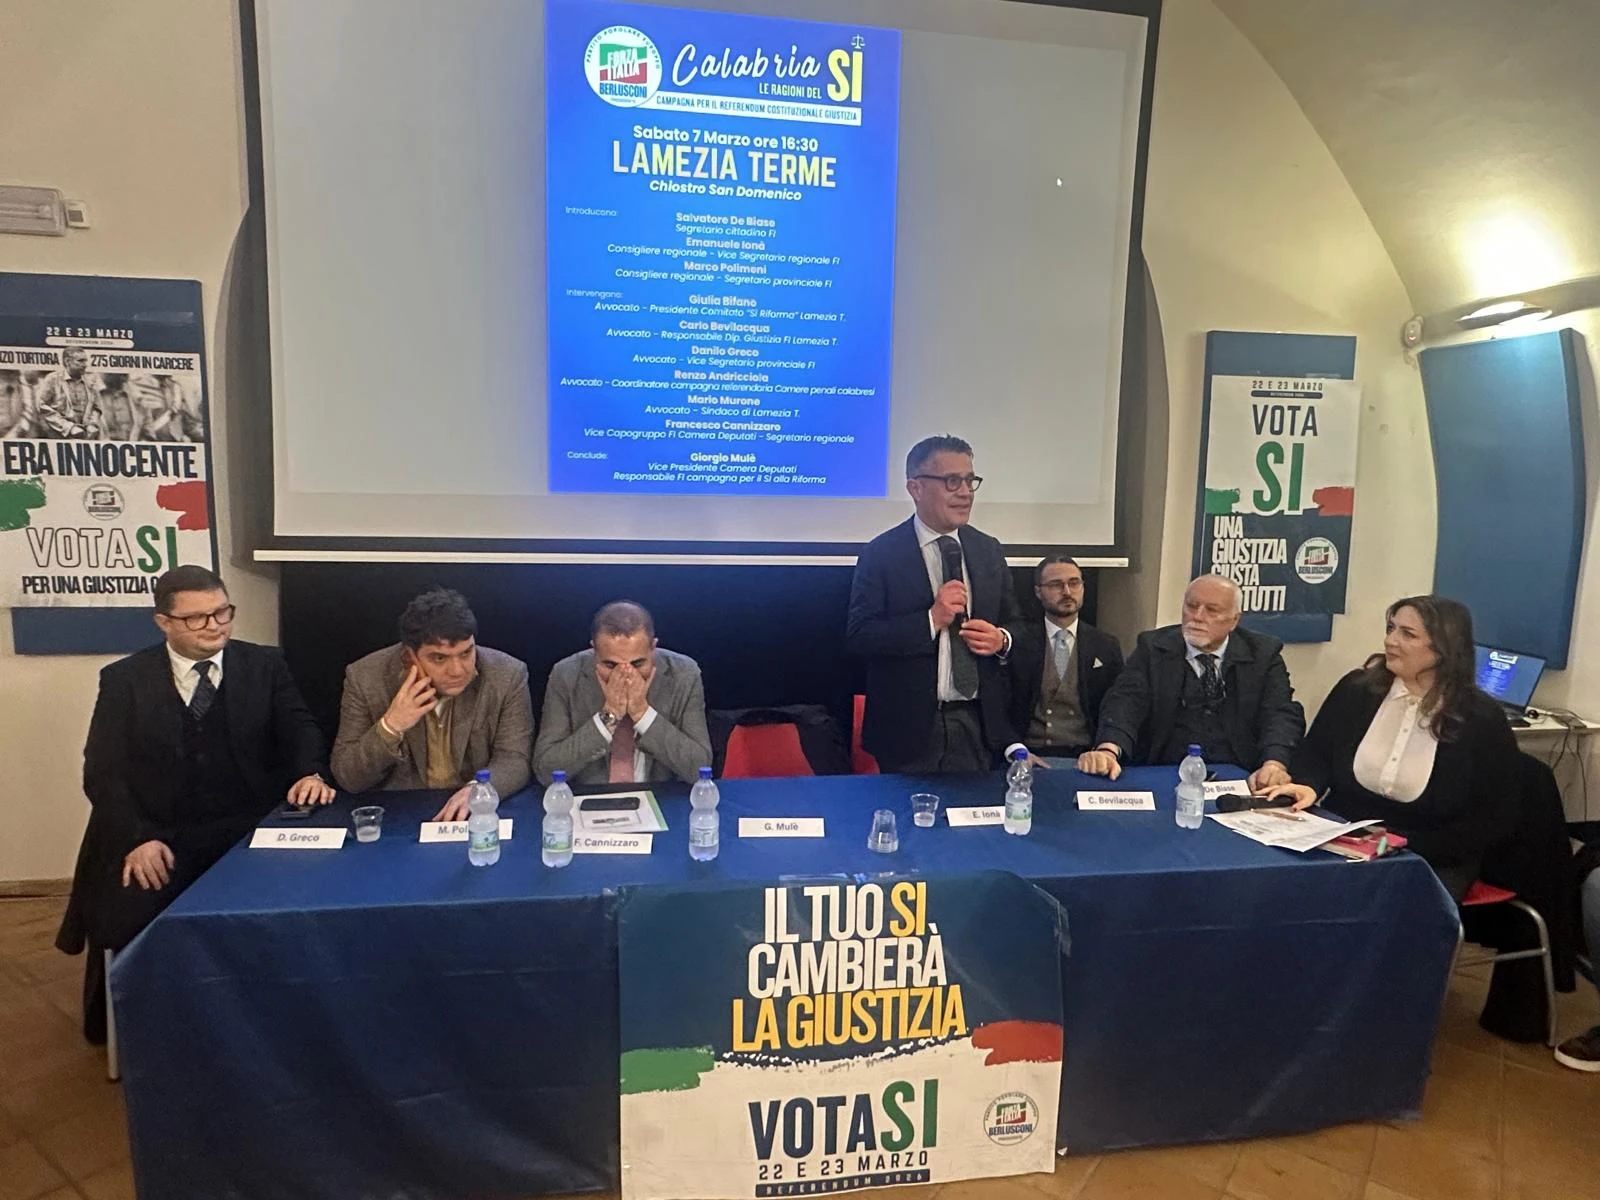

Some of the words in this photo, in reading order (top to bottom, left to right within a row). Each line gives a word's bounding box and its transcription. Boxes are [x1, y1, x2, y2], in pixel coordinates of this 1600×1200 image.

[607, 62, 640, 80] ITALIA
[672, 43, 821, 87] Calabria
[599, 82, 648, 98] BERLUSCONI
[759, 82, 769, 95] LE
[771, 84, 805, 98] RAGIONI
[807, 87, 822, 99] DEL
[656, 95, 695, 108] CAMPAGNA
[696, 99, 710, 108] PER
[719, 101, 765, 113] REFERENDUM
[767, 106, 823, 118] COSTITUZIONALE
[824, 110, 857, 121] GIUSTIZIA
[633, 125, 689, 141] Sabato
[692, 130, 701, 142] 7
[703, 131, 751, 146] Marzo
[753, 137, 778, 149] ore
[781, 136, 819, 152] 16:30
[612, 140, 738, 181] LAMEZIA
[748, 151, 837, 188] TERME
[649, 180, 706, 194] Chiostro
[708, 183, 735, 197] San
[736, 186, 802, 201] Domenico
[675, 212, 728, 224] Salvatore
[730, 215, 745, 225] De
[746, 217, 775, 227] Biase
[675, 224, 723, 236] Segretario
[725, 227, 766, 237] cittadino
[686, 237, 740, 248] Emanuele
[607, 243, 660, 256] Consigliere
[662, 247, 707, 258] regionale
[717, 250, 737, 259] Vice
[739, 251, 786, 262] Segretario
[787, 255, 830, 265] regionale
[683, 261, 719, 272] Marco
[720, 263, 767, 274] Polimeni
[615, 268, 668, 280] Consigliere
[670, 272, 714, 283] regionale
[724, 274, 771, 285] Segretario
[772, 278, 823, 288] provinciale
[688, 295, 720, 305] Giulia
[722, 296, 757, 307] Bifano
[594, 302, 640, 312] Avvocato
[649, 304, 699, 315] Presidente
[700, 306, 744, 317] Comitato
[800, 312, 837, 321] Lamezia
[46, 326, 60, 336] 22
[65, 327, 72, 336] E
[77, 327, 91, 337] 23
[96, 328, 134, 339] MARZO
[679, 320, 709, 330] Carlo
[710, 321, 770, 334] Bevilacqua
[606, 328, 652, 338] Avvocato
[661, 330, 723, 341] Responsabile
[744, 334, 781, 344] Giustizia
[792, 336, 830, 346] Lamezia
[15, 351, 60, 365] TORTORA
[691, 345, 726, 356] Danilo
[727, 347, 759, 357] Greco
[90, 354, 108, 367] 275
[109, 355, 141, 369] GIORNI
[142, 356, 151, 369] IN
[152, 356, 194, 370] CARCERE
[632, 354, 677, 364] Avvocato
[687, 356, 706, 365] Vice
[708, 357, 755, 368] Segretario
[756, 359, 806, 369] provinciale
[674, 369, 706, 380] Renzo
[560, 377, 603, 387] Avvocato
[611, 379, 669, 389] Coordinatore
[670, 382, 720, 393] campagna
[721, 383, 773, 393] referendaria
[774, 384, 809, 394] Camere
[809, 386, 837, 396] penali
[837, 386, 876, 396] calabresi
[1252, 380, 1263, 389] 22
[1268, 380, 1273, 389] E
[1277, 381, 1288, 390] 23
[1293, 381, 1323, 391] MARZO
[687, 395, 719, 404] Mario
[720, 396, 761, 406] Murone
[645, 405, 691, 414] Avvocato
[701, 406, 740, 416] Sindaco
[741, 407, 751, 417] di
[752, 408, 792, 417] Lamezia
[665, 419, 721, 430] Francesco
[722, 421, 781, 431] Cannizzaro
[1252, 404, 1318, 436] VOTA
[583, 428, 604, 437] Vice
[606, 428, 666, 440] Capogruppo
[678, 430, 716, 439] Camera
[717, 431, 757, 442] Deputati
[765, 432, 812, 443] Segretario
[813, 435, 855, 445] regionale
[3, 441, 55, 475] ERA
[56, 442, 198, 479] INNOCENTE
[690, 452, 729, 464] Giorgio
[730, 452, 756, 463] Mulè
[648, 462, 668, 471] Vice
[669, 463, 718, 472] Presidente
[719, 464, 757, 473] Camera
[758, 464, 797, 475] Deputati
[1252, 440, 1305, 512] SI
[613, 471, 675, 482] Responsabile
[686, 474, 737, 484] campagna
[738, 475, 754, 484] per
[773, 475, 791, 483] alla
[791, 475, 826, 484] Riforma
[1213, 515, 1244, 539] UNA
[1211, 538, 1288, 564] GIUSTIZIA
[21, 575, 49, 594] PER
[52, 576, 81, 594] UNA
[82, 576, 149, 594] GIUSTIZIA
[1242, 585, 1287, 612] TUTTI
[1098, 796, 1144, 806] Bevilacqua
[438, 825, 449, 834] M.
[764, 822, 774, 831] G.
[776, 822, 799, 831] Mulè
[277, 833, 287, 841] D.
[290, 833, 320, 842] Greco
[584, 838, 639, 847] Cannizzaro
[765, 887, 800, 943] IL
[804, 883, 884, 941] TUO
[889, 881, 927, 937] SI
[748, 922, 947, 999] CAMBIERÀ
[732, 998, 782, 1052] LA
[786, 984, 967, 1049] GIUSTIZIA
[748, 1093, 877, 1160] VOTA
[758, 1163, 783, 1180] 22
[797, 1162, 806, 1178] E
[820, 1158, 844, 1176] 23
[857, 1150, 928, 1172] MARZO
[766, 1176, 871, 1195] REFERENDUM
